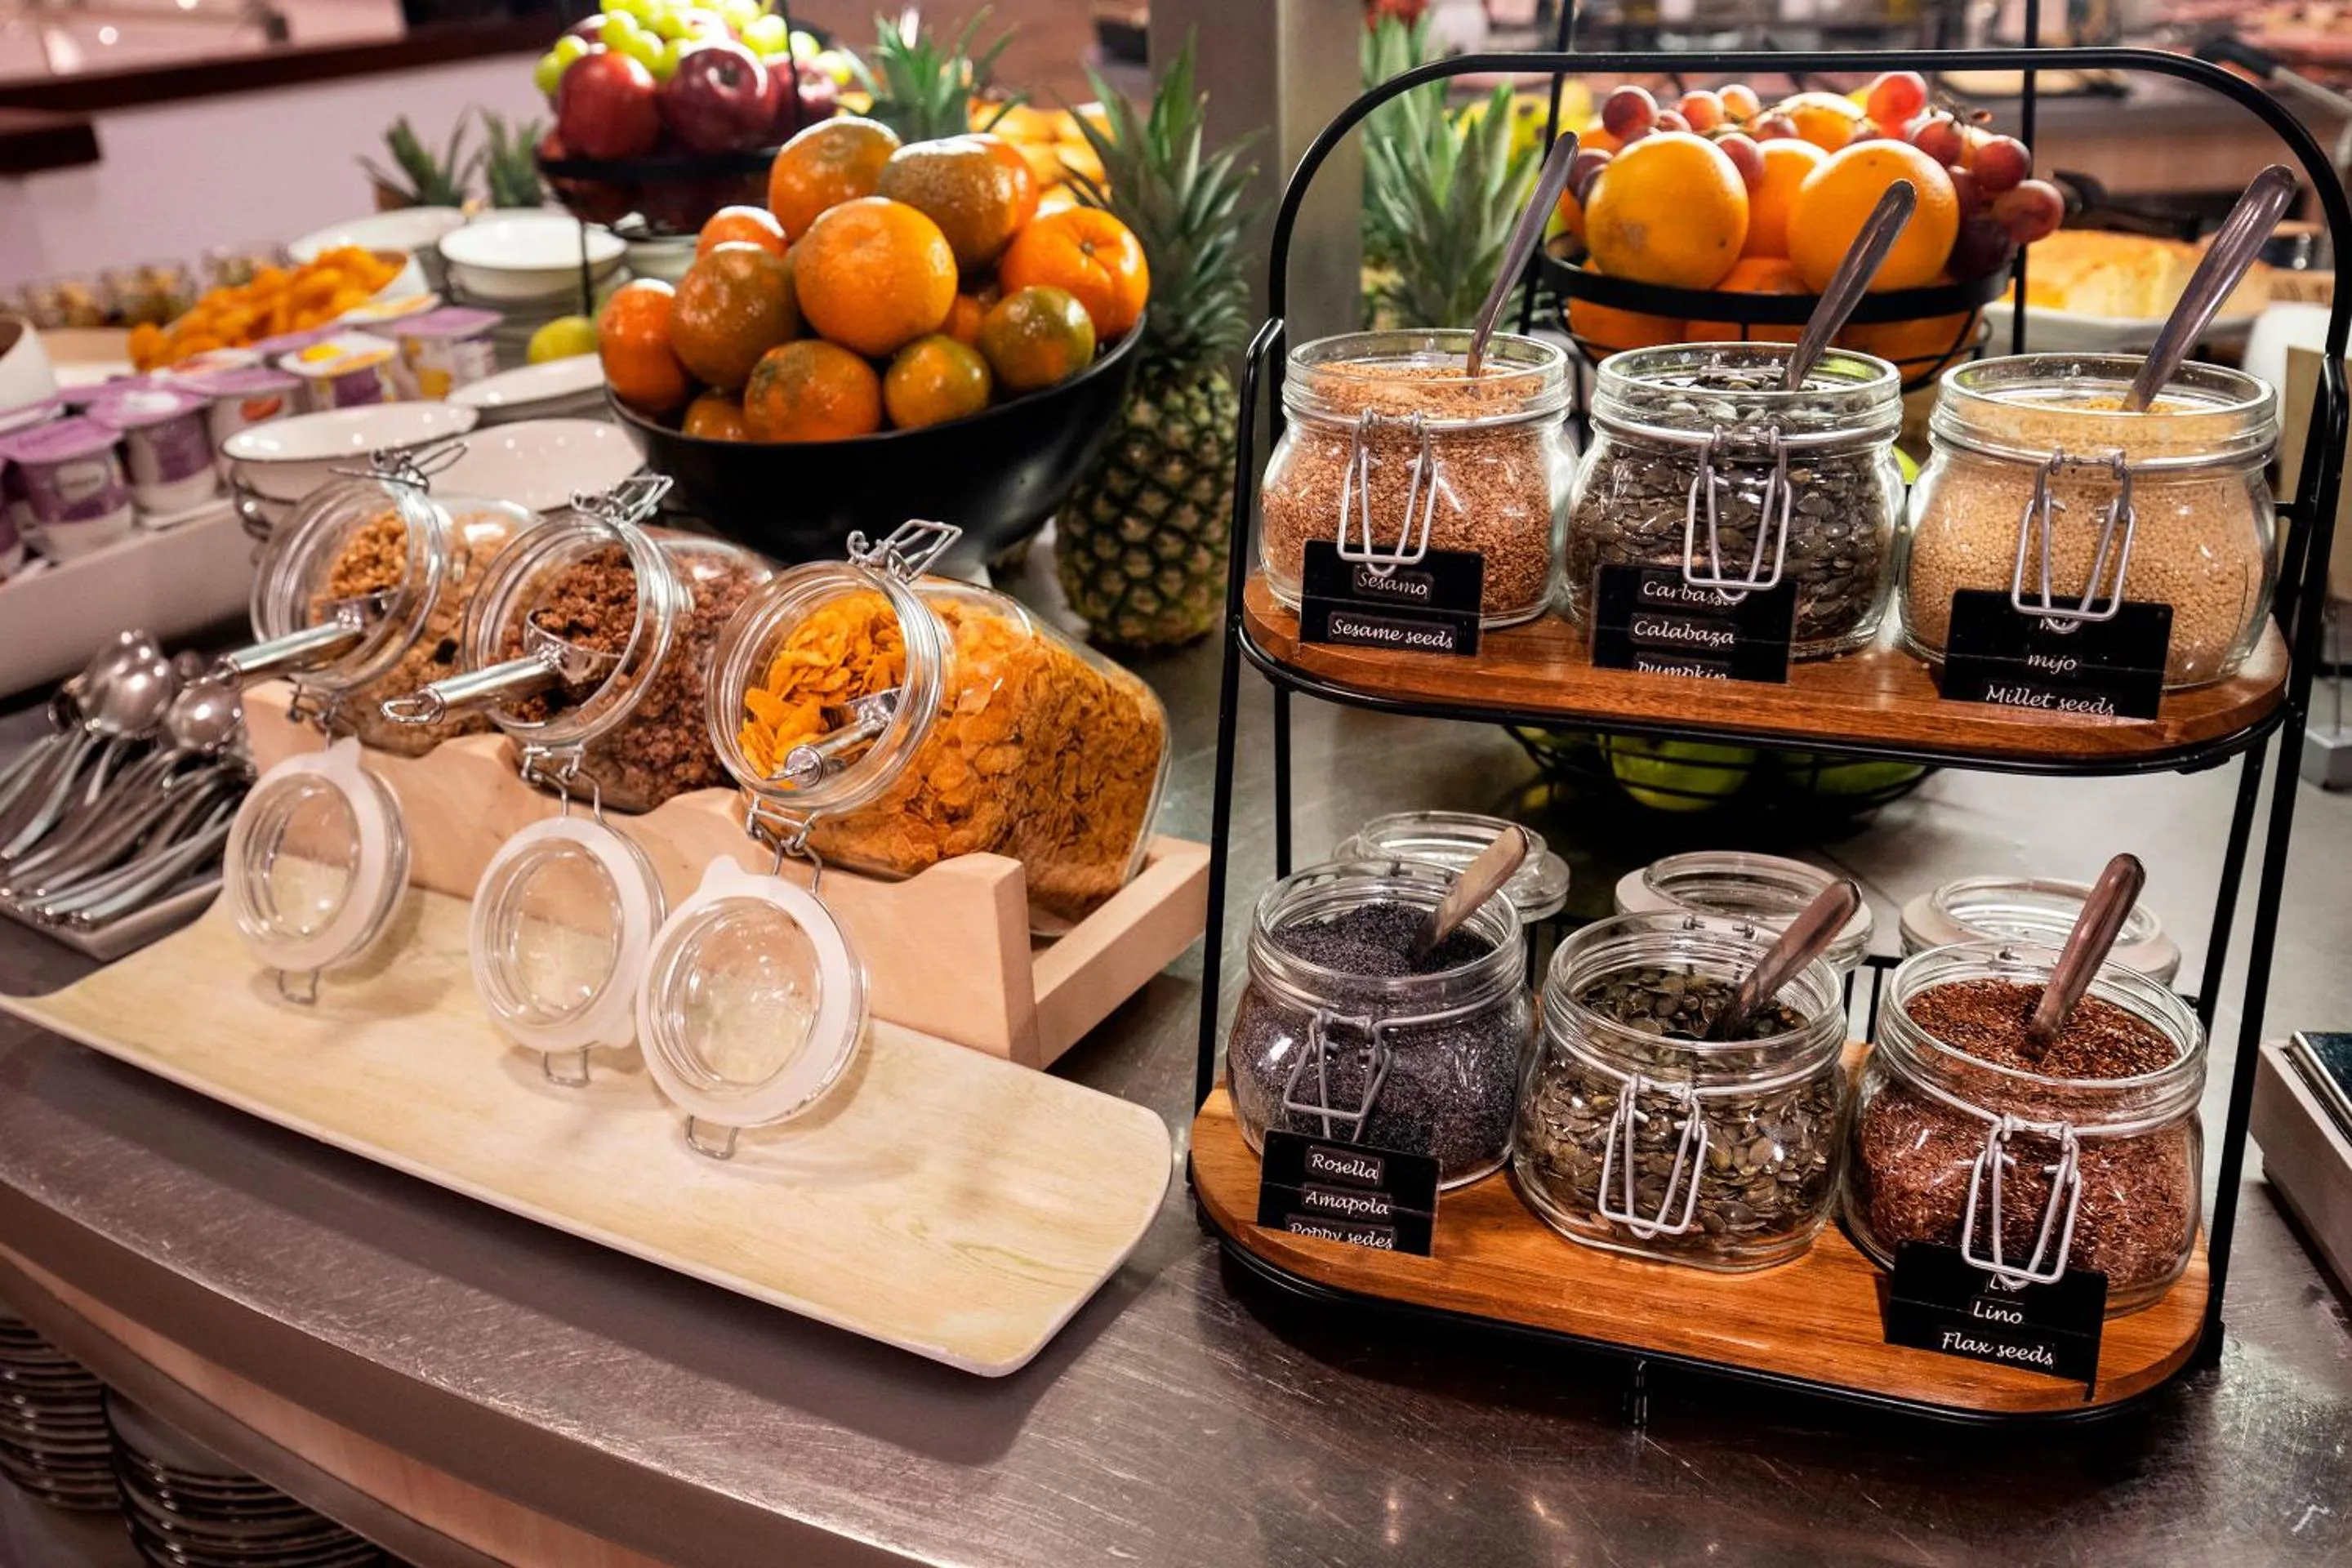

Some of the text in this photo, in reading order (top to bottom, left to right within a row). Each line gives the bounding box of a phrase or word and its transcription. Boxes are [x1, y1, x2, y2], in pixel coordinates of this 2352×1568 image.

[1357, 572, 1428, 596] Sesamo
[1643, 581, 1736, 607] Carbass
[1332, 618, 1454, 650] Sesame seeds
[1634, 618, 1735, 648] Calabaza
[2028, 654, 2077, 675] mijo
[1985, 684, 2115, 717] Millet seeds
[1312, 1153, 1379, 1181] Rosella
[1305, 1191, 1389, 1215] Amapola
[1347, 1230, 1393, 1250] sedes
[1973, 1301, 2023, 1325] Lino
[1942, 1331, 2054, 1366] Flax seeds
